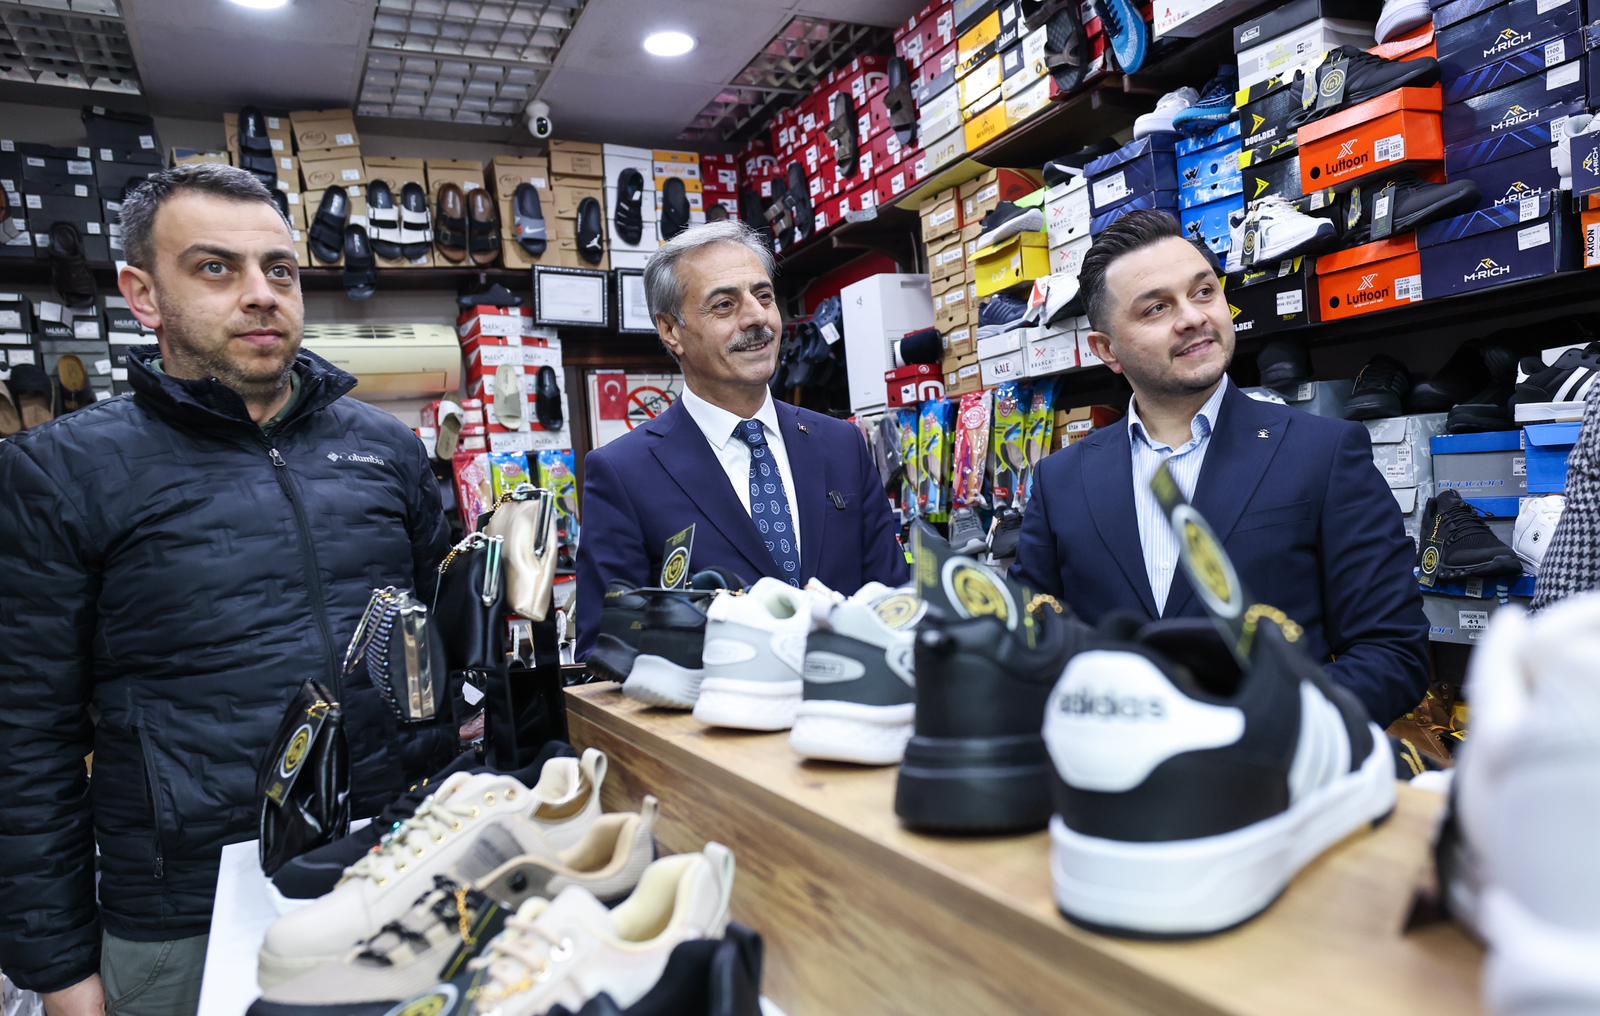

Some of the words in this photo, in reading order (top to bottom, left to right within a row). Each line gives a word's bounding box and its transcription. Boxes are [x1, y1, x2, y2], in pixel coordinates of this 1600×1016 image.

[1483, 31, 1532, 58] M-RICH
[1491, 109, 1540, 132] M-RICH
[1244, 128, 1277, 147] BOULDER
[1326, 153, 1369, 175] Luttoon
[1592, 147, 1600, 176] M-RICH
[1494, 187, 1542, 207] M-RICH
[1587, 229, 1595, 257] AXION
[1463, 265, 1511, 283] M-RICH
[1346, 288, 1389, 305] Luttoon
[994, 362, 1010, 375] KALE
[1060, 688, 1166, 718] adidas
